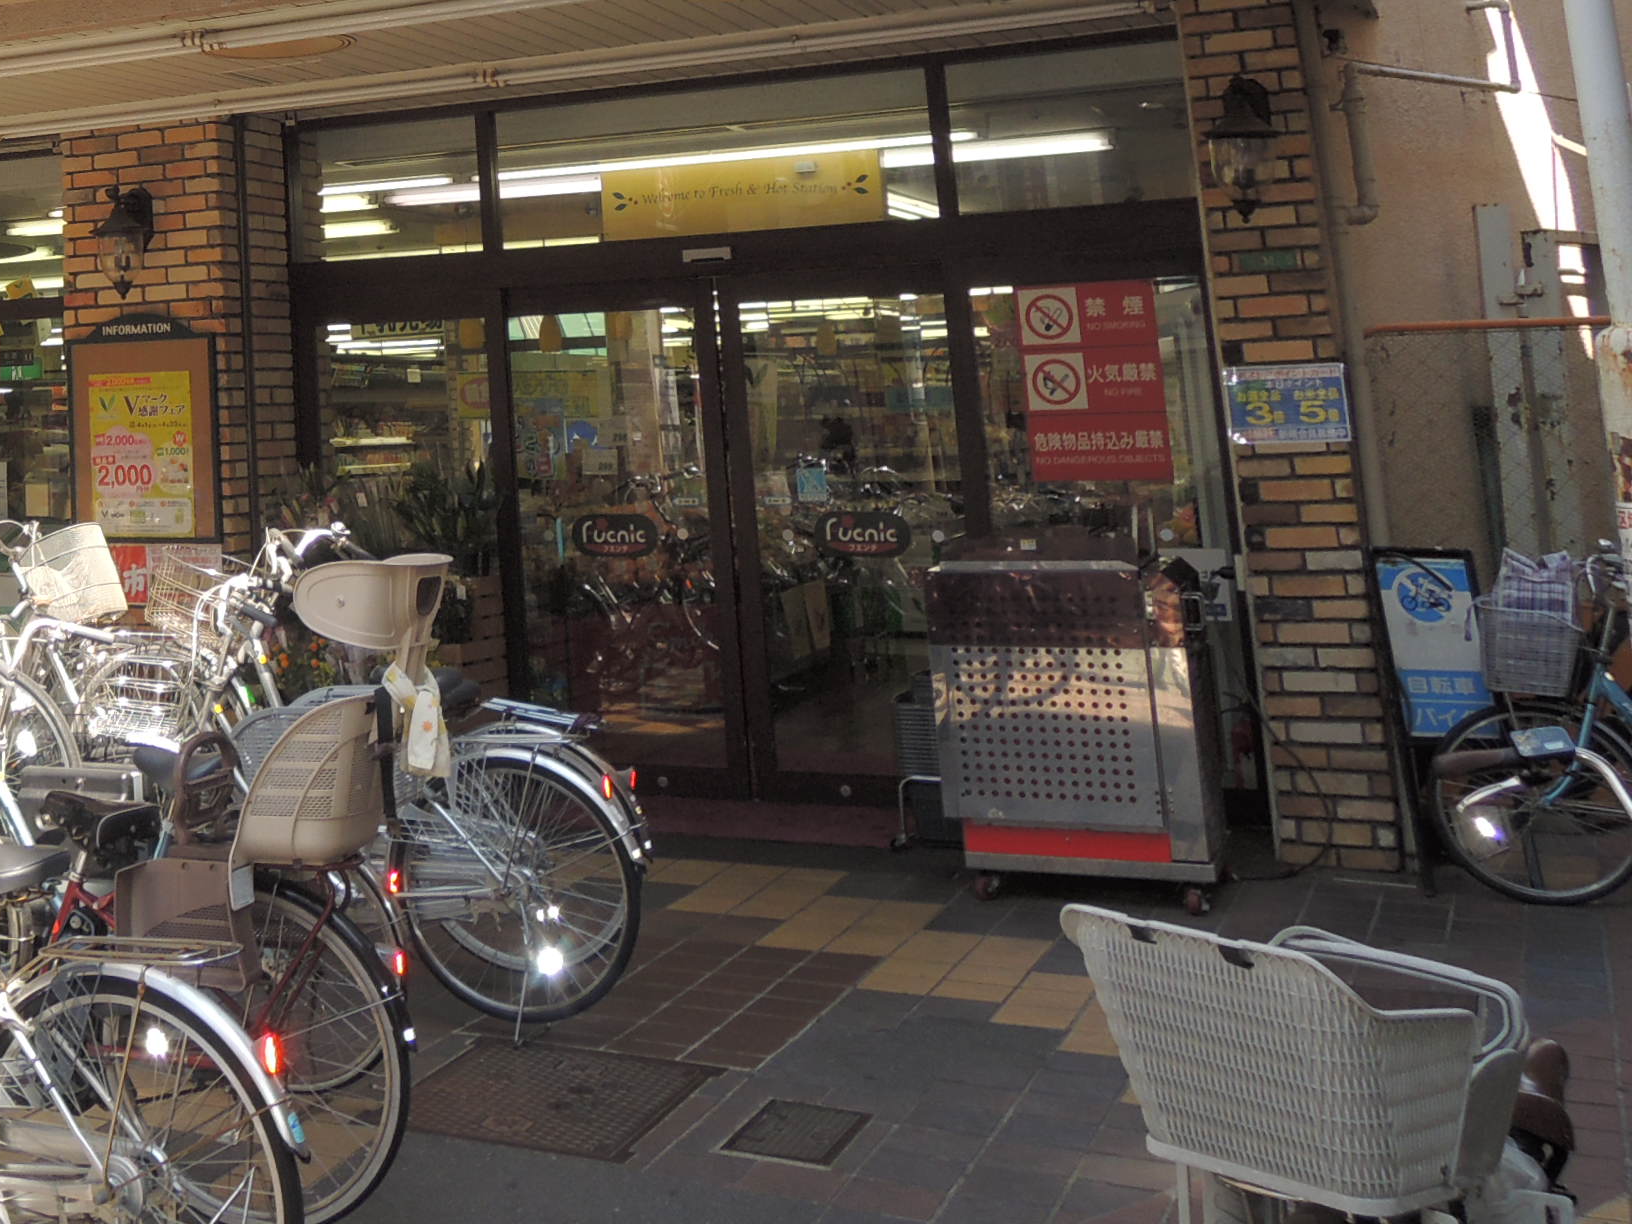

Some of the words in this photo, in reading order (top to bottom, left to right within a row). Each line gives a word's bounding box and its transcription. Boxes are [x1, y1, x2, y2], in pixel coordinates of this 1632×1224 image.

[642, 187, 690, 205] Welcome
[694, 189, 706, 201] to
[709, 184, 744, 199] Fresh
[747, 185, 760, 196] &
[765, 182, 788, 195] Hot
[791, 181, 839, 195] Station
[1085, 295, 1144, 317] 禁煙
[102, 322, 171, 336] INFORMATION
[1087, 362, 1158, 384] 火気厳禁
[1033, 429, 1165, 452] 危険物品持込み厳禁
[97, 463, 153, 489] 2,000
[1407, 675, 1477, 696] 自転車
